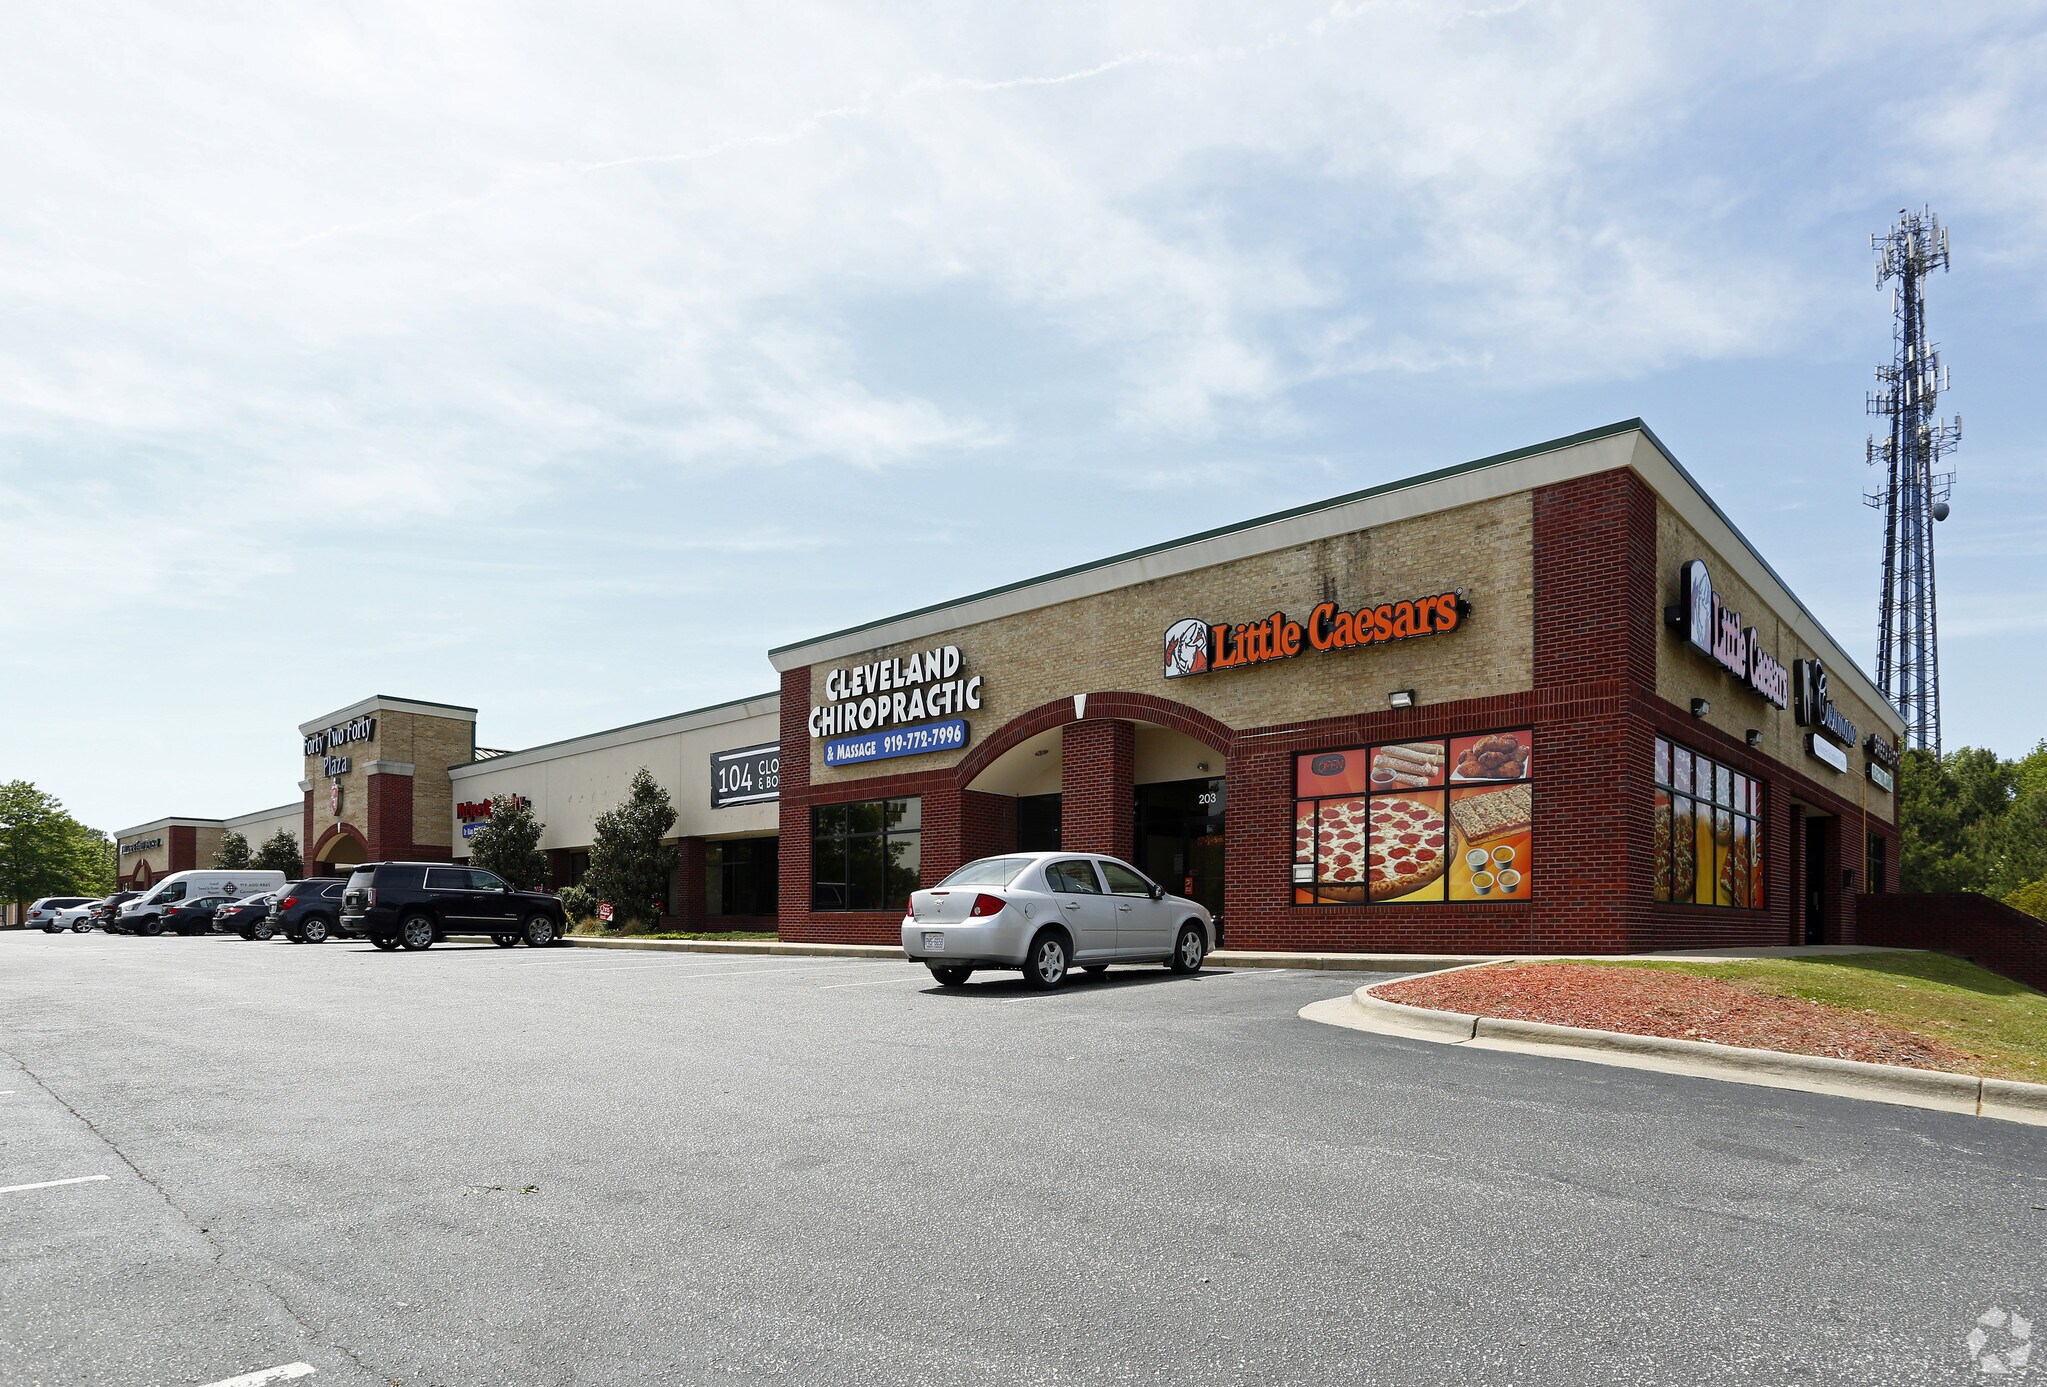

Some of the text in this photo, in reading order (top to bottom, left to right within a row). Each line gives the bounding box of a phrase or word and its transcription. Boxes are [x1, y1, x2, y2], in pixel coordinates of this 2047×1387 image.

[1211, 592, 1458, 669] Little Caesars
[1712, 591, 1788, 710] Little Caesars
[825, 645, 961, 702] CLEVELAND
[808, 675, 982, 738] CHIROPRACTIC
[303, 717, 373, 757] Forty Two Forty
[826, 724, 962, 762] & MASSAGE 919-772-7996
[323, 755, 348, 777] Plaza
[718, 758, 781, 793] 104 CLO
[766, 775, 781, 789] BO
[1318, 759, 1344, 773] OPEN
[1198, 793, 1217, 805] 203
